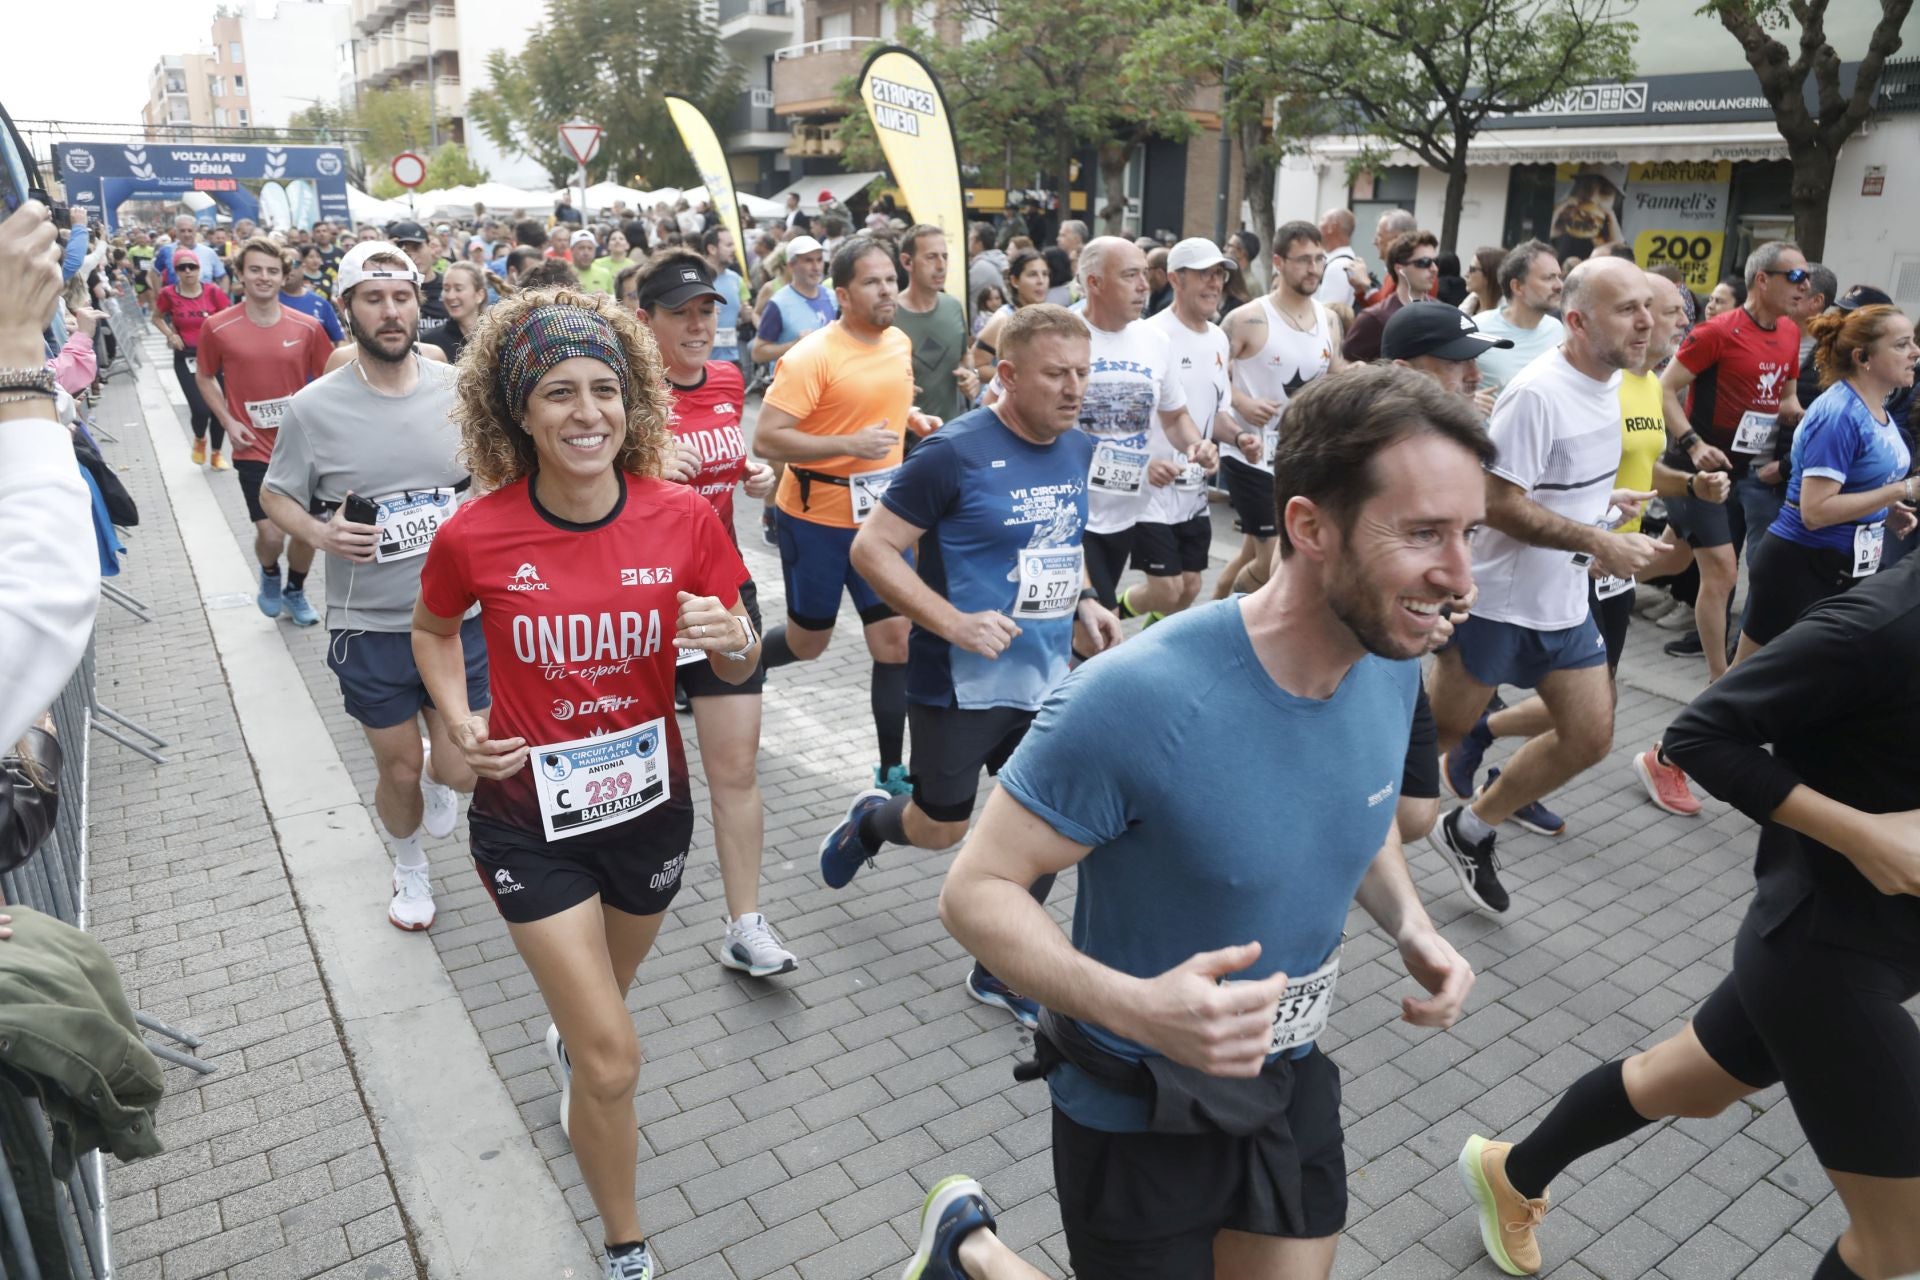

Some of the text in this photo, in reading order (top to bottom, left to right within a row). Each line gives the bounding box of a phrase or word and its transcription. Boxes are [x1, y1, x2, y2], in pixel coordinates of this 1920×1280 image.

[171, 151, 210, 161] VOLTA
[222, 152, 246, 162] PEU
[188, 162, 233, 175] DÉNIA
[1641, 168, 1717, 180] APERTURA
[1636, 191, 1717, 211] Fanneli's
[1648, 235, 1712, 261] 200
[1092, 357, 1152, 379] ÉNIA
[1097, 466, 1132, 483] D 530
[1010, 484, 1073, 500] VII CIRCUIT
[393, 499, 428, 512] MARINA ALTA
[403, 507, 423, 517] CARLOS
[381, 514, 438, 542] A 1045
[1862, 549, 1868, 561] D
[1029, 580, 1069, 598] D 577
[512, 609, 662, 665] ONDARA
[538, 654, 643, 687] tri-esport
[571, 746, 607, 760] CIRCUIT
[615, 739, 633, 751] PEU
[578, 749, 630, 767] MARINA ALTA
[588, 759, 625, 775] ANTONIA
[556, 772, 633, 809] C 239
[581, 792, 643, 821] BALEARIA
